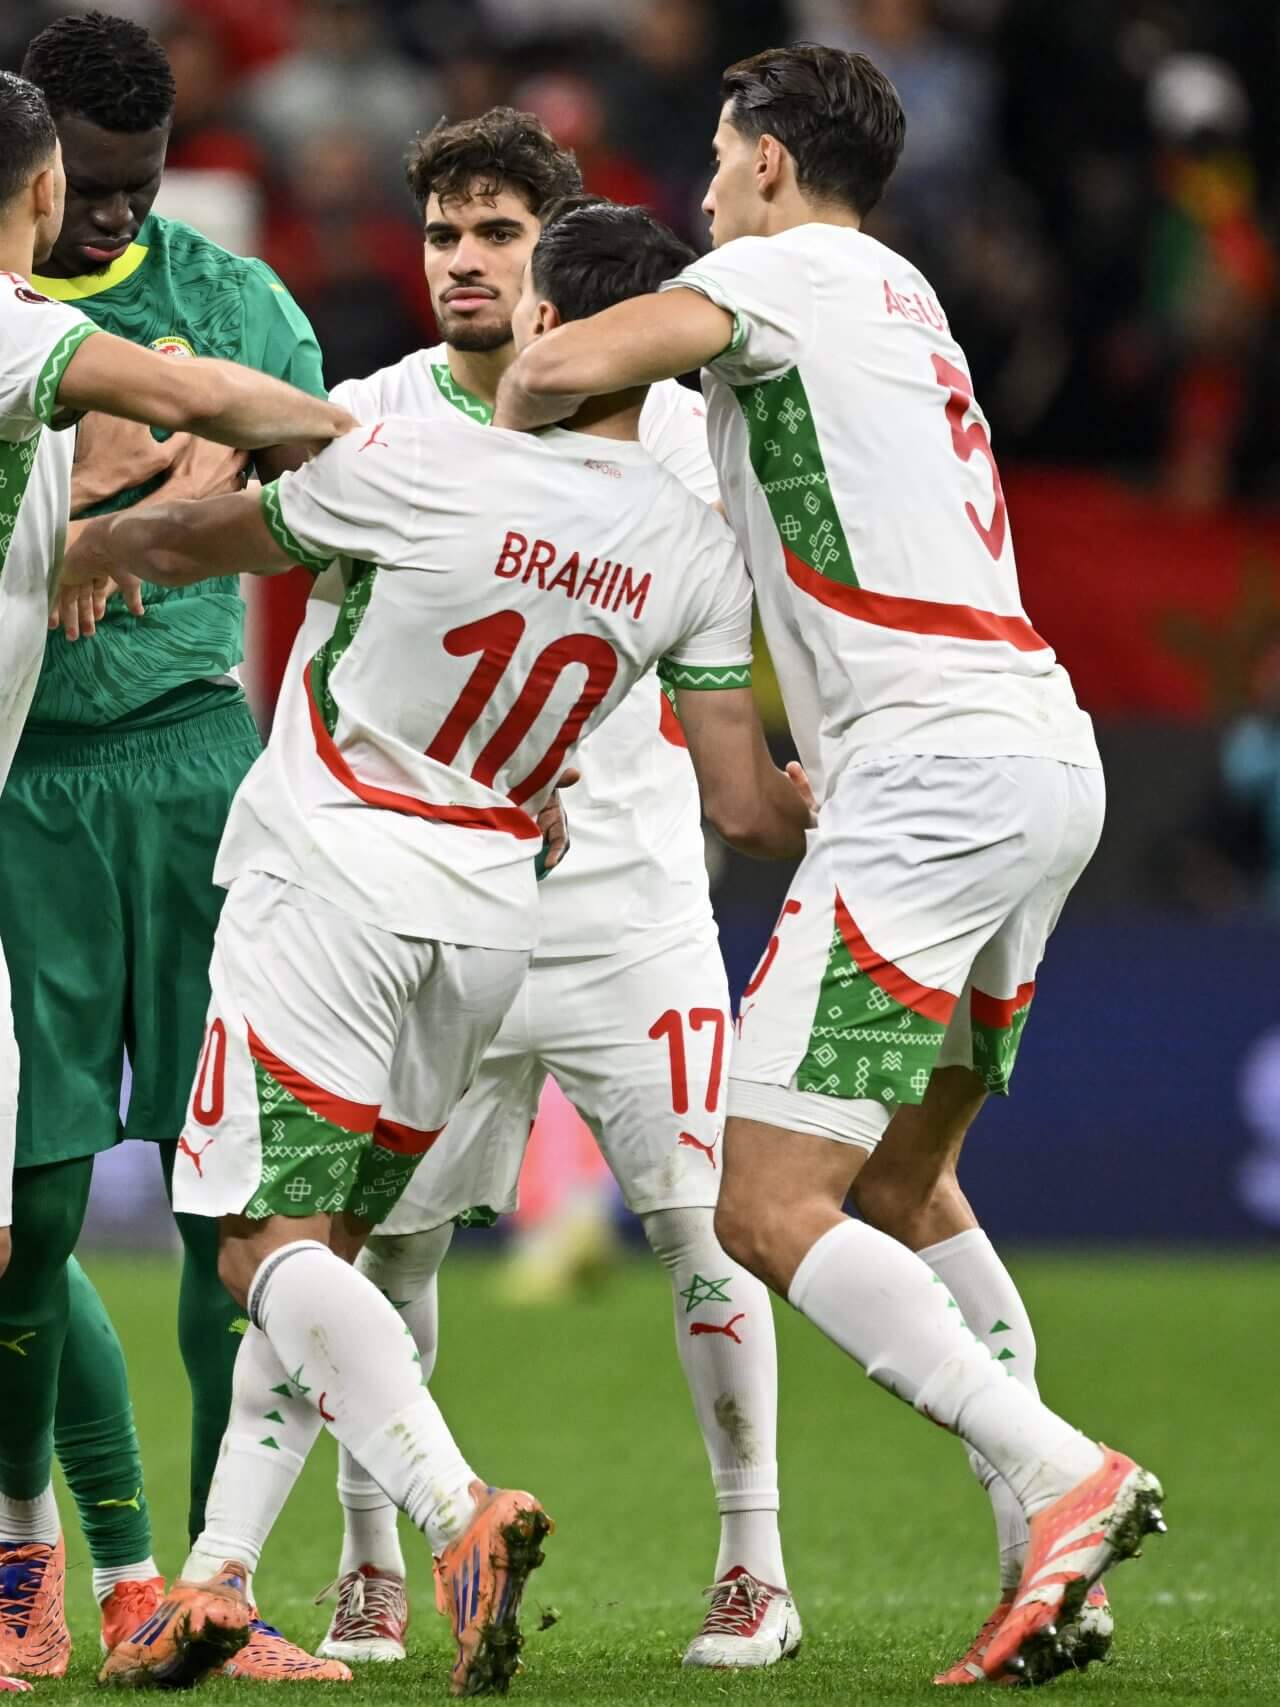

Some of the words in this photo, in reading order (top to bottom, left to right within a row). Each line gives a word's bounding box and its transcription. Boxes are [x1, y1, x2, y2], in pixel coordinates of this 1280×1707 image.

[931, 352, 1007, 561] 5
[494, 531, 653, 620] BRAHIM
[424, 609, 619, 806] 10
[647, 1007, 725, 1115] 17
